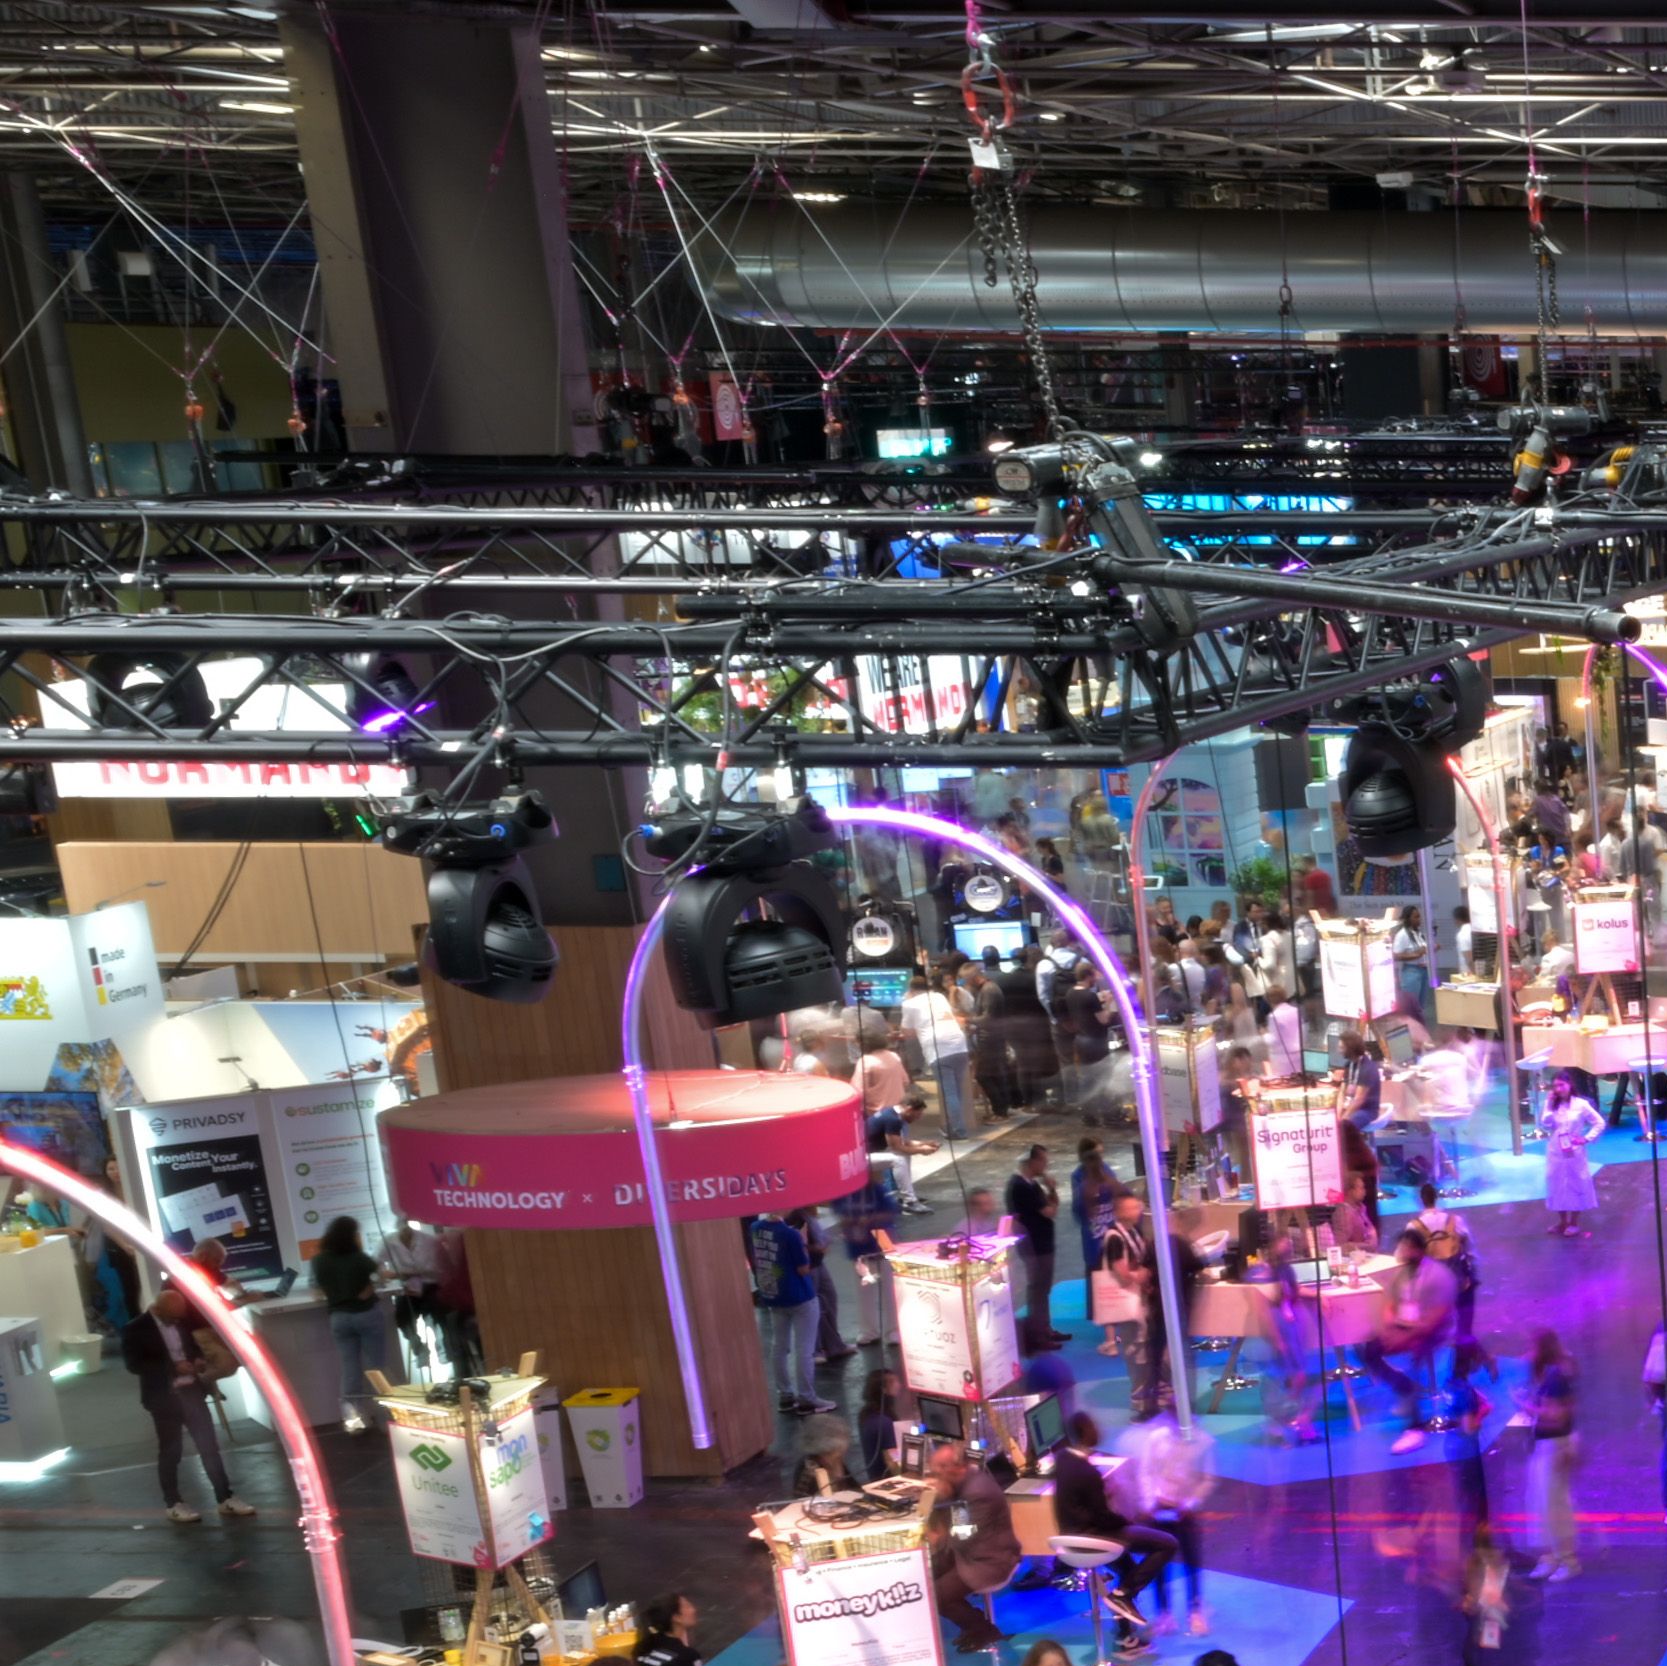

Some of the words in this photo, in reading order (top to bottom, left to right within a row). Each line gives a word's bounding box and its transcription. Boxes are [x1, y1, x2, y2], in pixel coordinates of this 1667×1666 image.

[1596, 918, 1629, 931] kolus
[172, 1110, 247, 1132] PRIVADSY
[1257, 1125, 1335, 1149] Signaturit
[152, 1149, 211, 1167] Monetize
[211, 1151, 240, 1166] Your
[1293, 1142, 1329, 1156] Group
[170, 1158, 212, 1174] Content
[433, 1188, 565, 1210] TECHNOLOGY
[614, 1169, 789, 1206] DIERSIDAYS
[411, 1474, 460, 1498] Unitee
